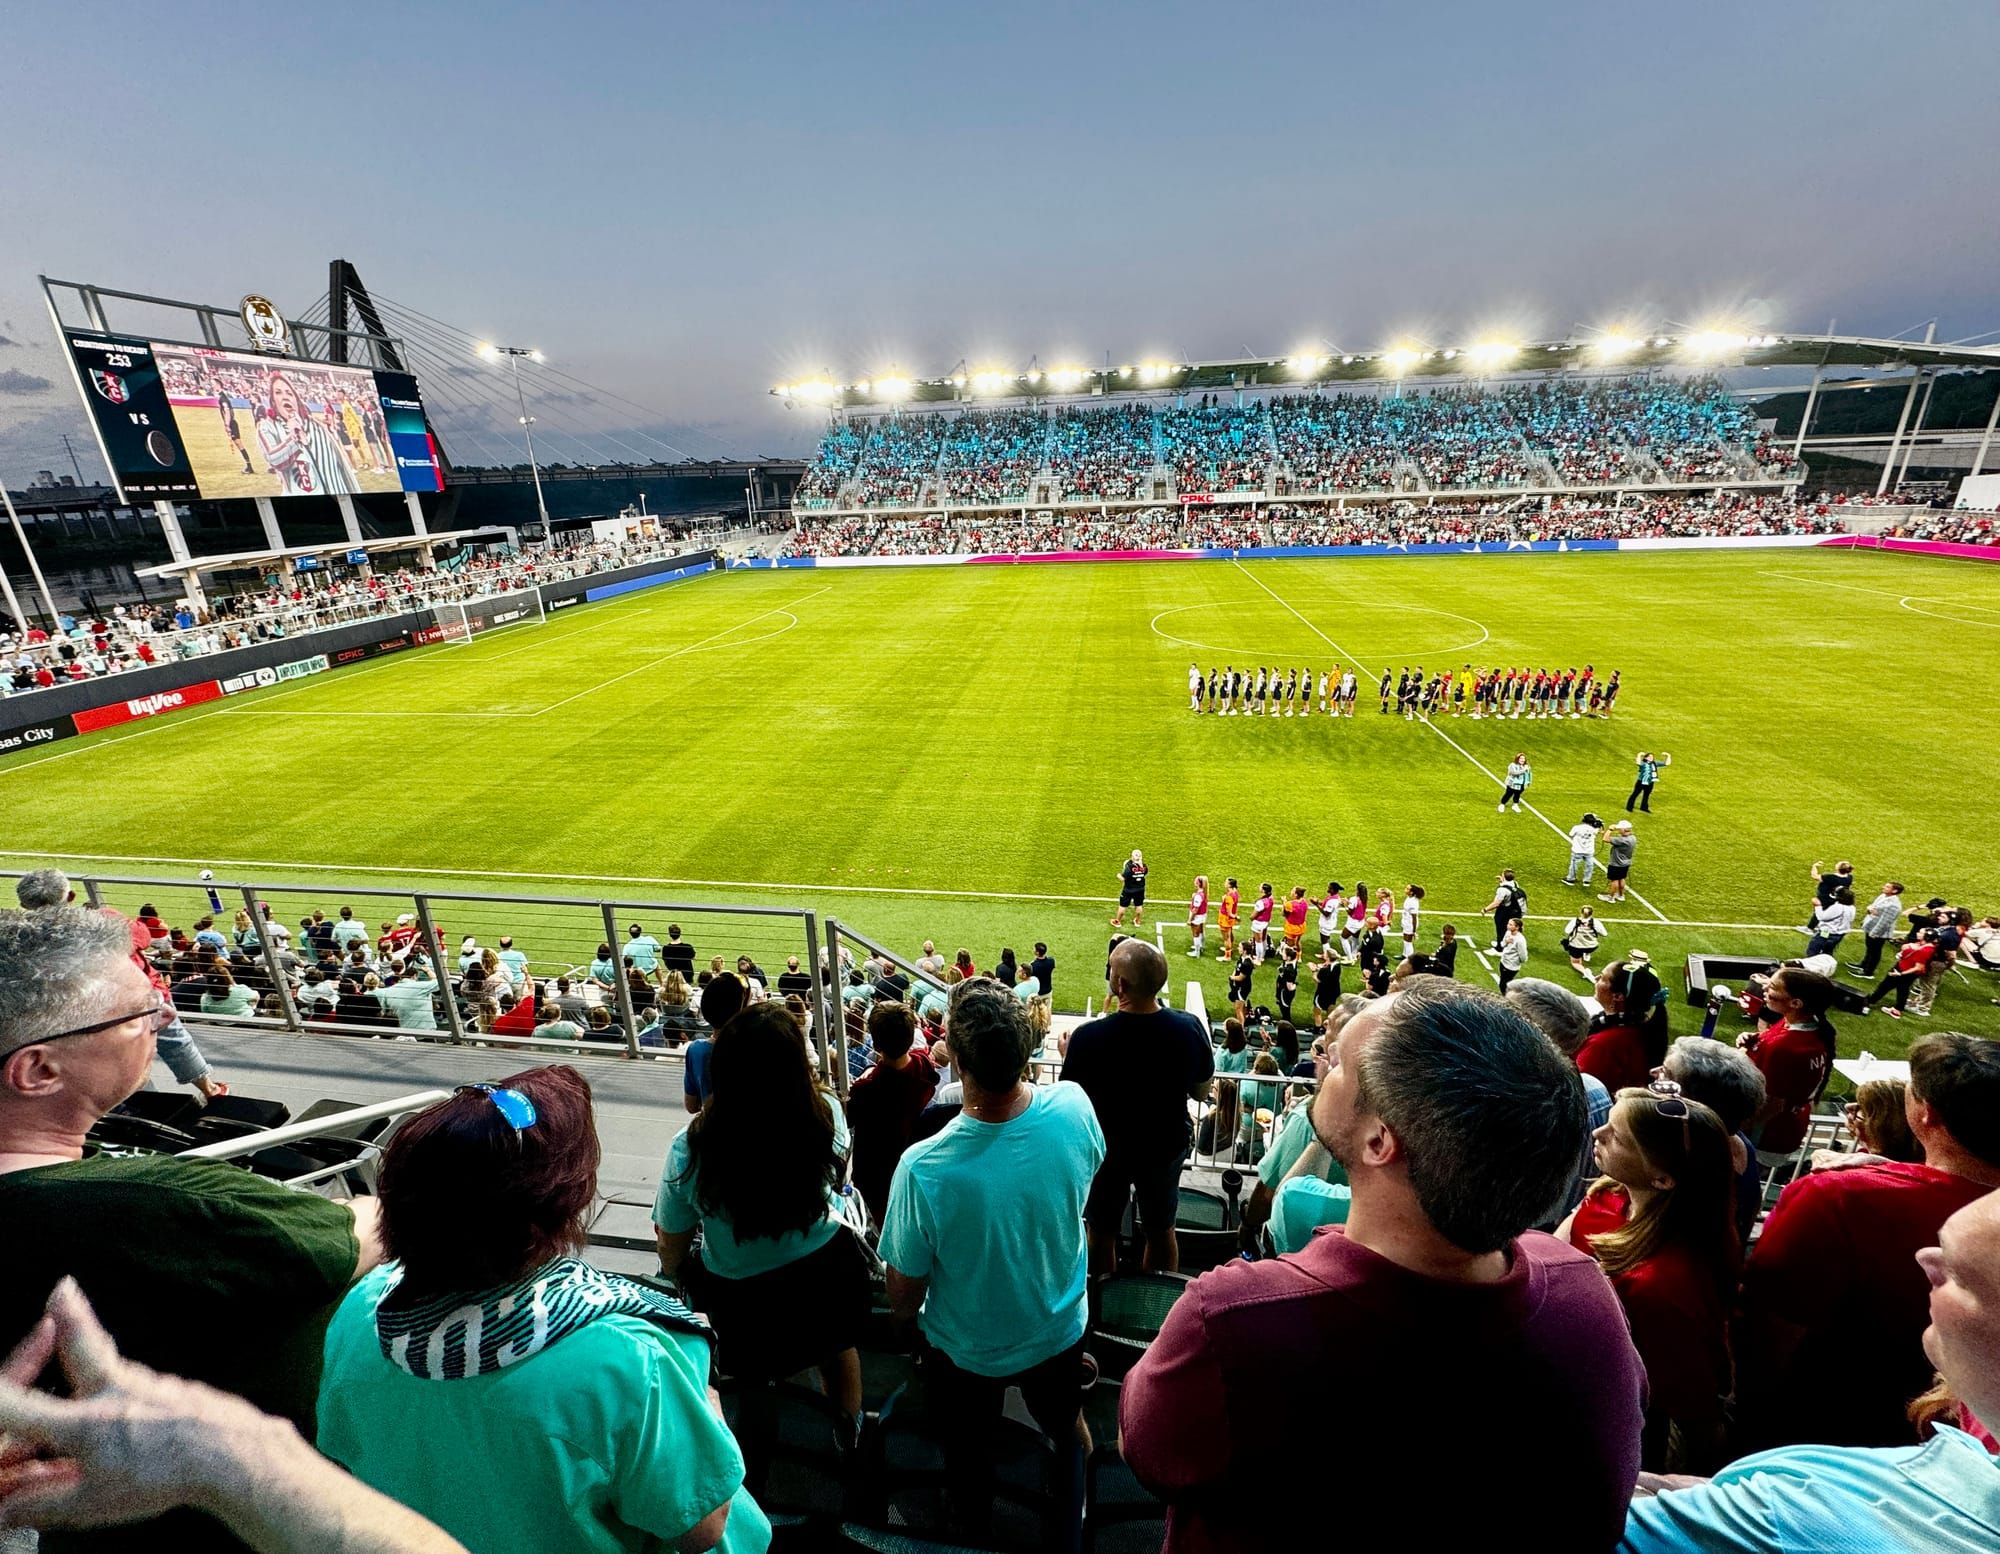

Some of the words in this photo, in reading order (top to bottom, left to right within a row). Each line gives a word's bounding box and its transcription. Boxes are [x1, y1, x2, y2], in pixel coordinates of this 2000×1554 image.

[1180, 494, 1215, 504] CPKC
[337, 648, 365, 661] CPKC
[24, 727, 55, 741] City
